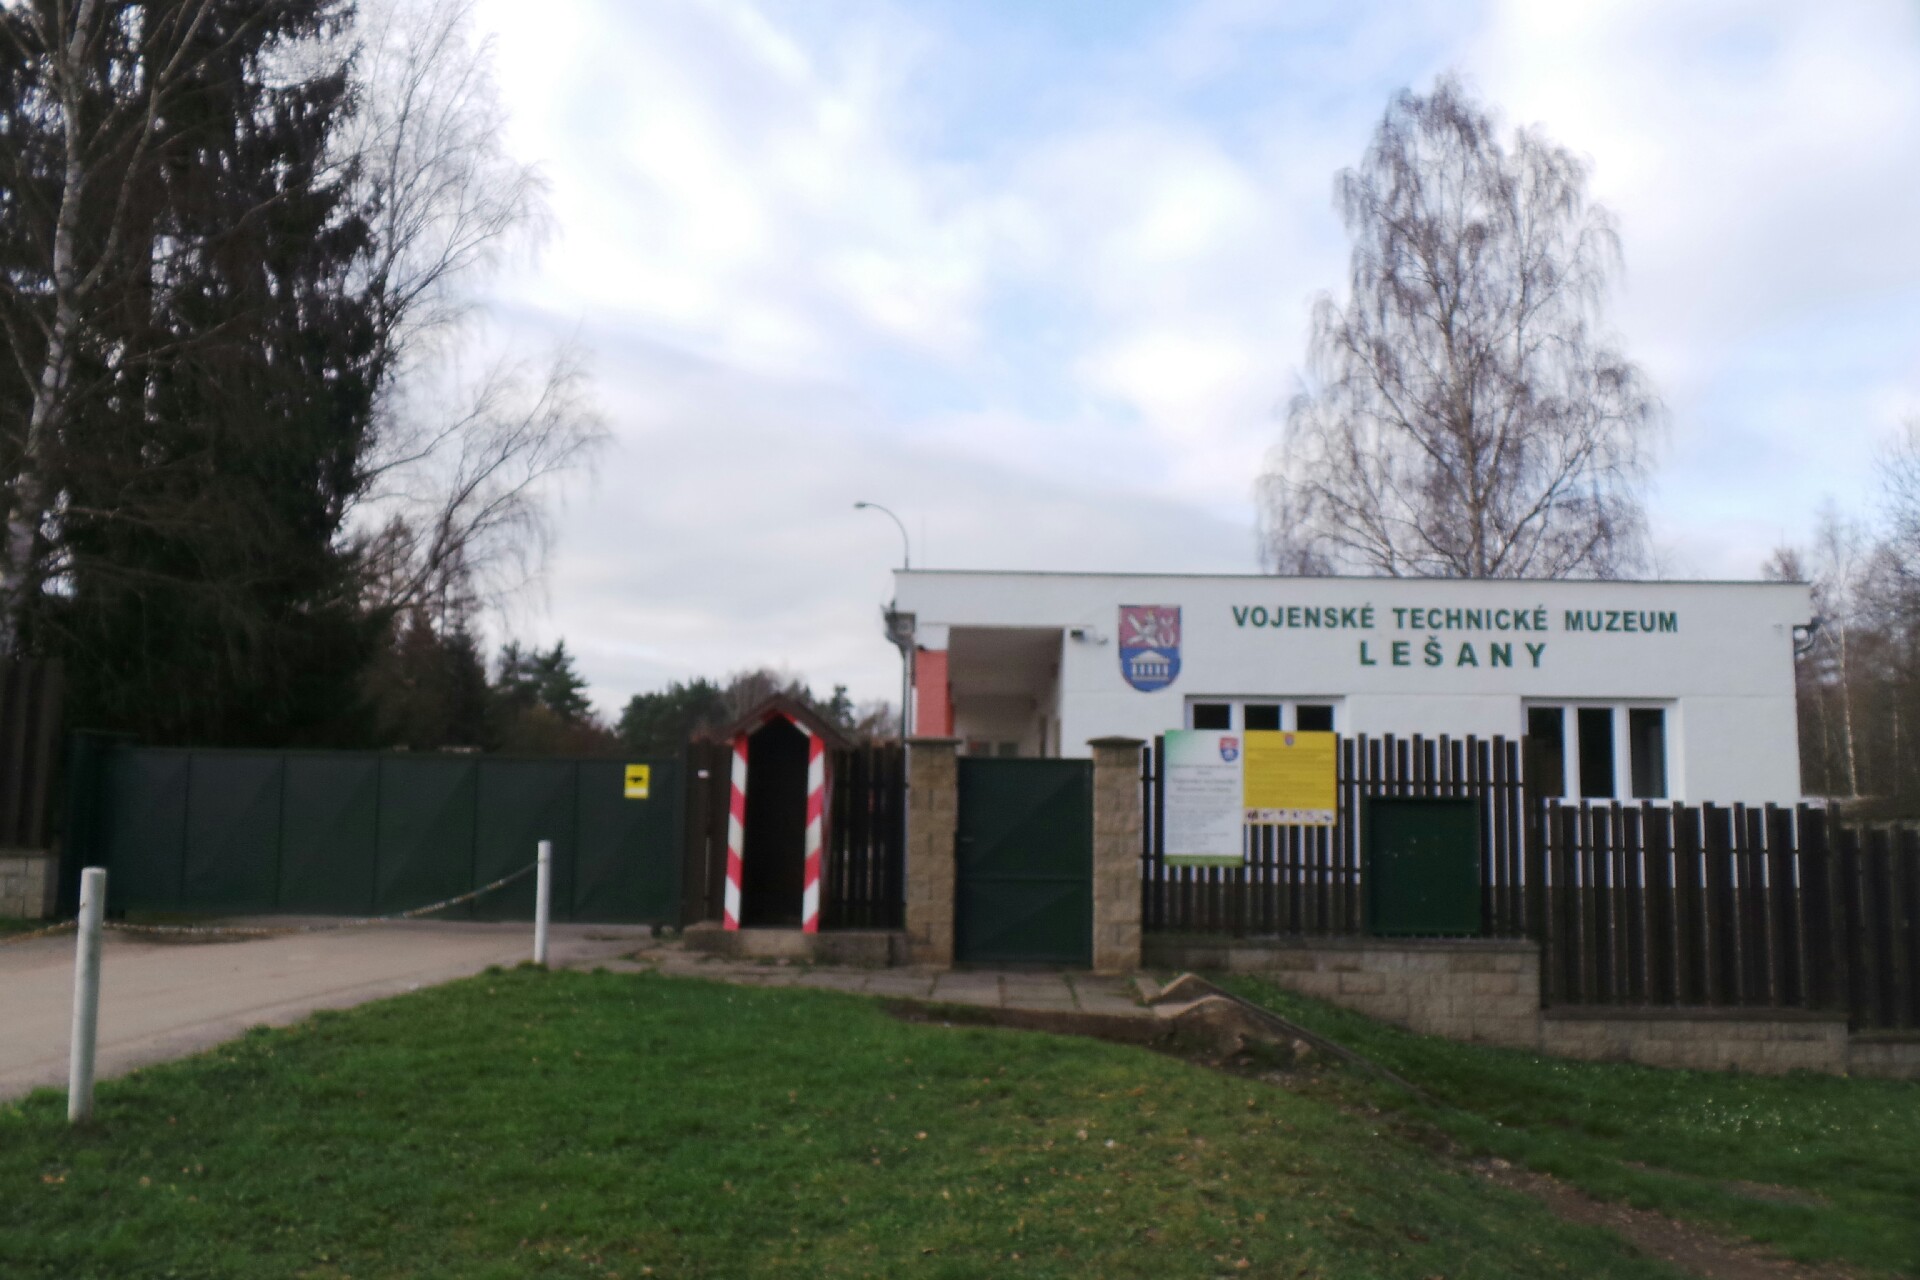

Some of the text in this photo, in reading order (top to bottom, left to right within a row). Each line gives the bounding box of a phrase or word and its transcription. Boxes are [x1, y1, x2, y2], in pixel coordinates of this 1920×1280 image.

[1232, 603, 1678, 633] VOJENSKÉ TECHNICKÉ MUZEUM
[1360, 636, 1546, 667] LEŠANY
